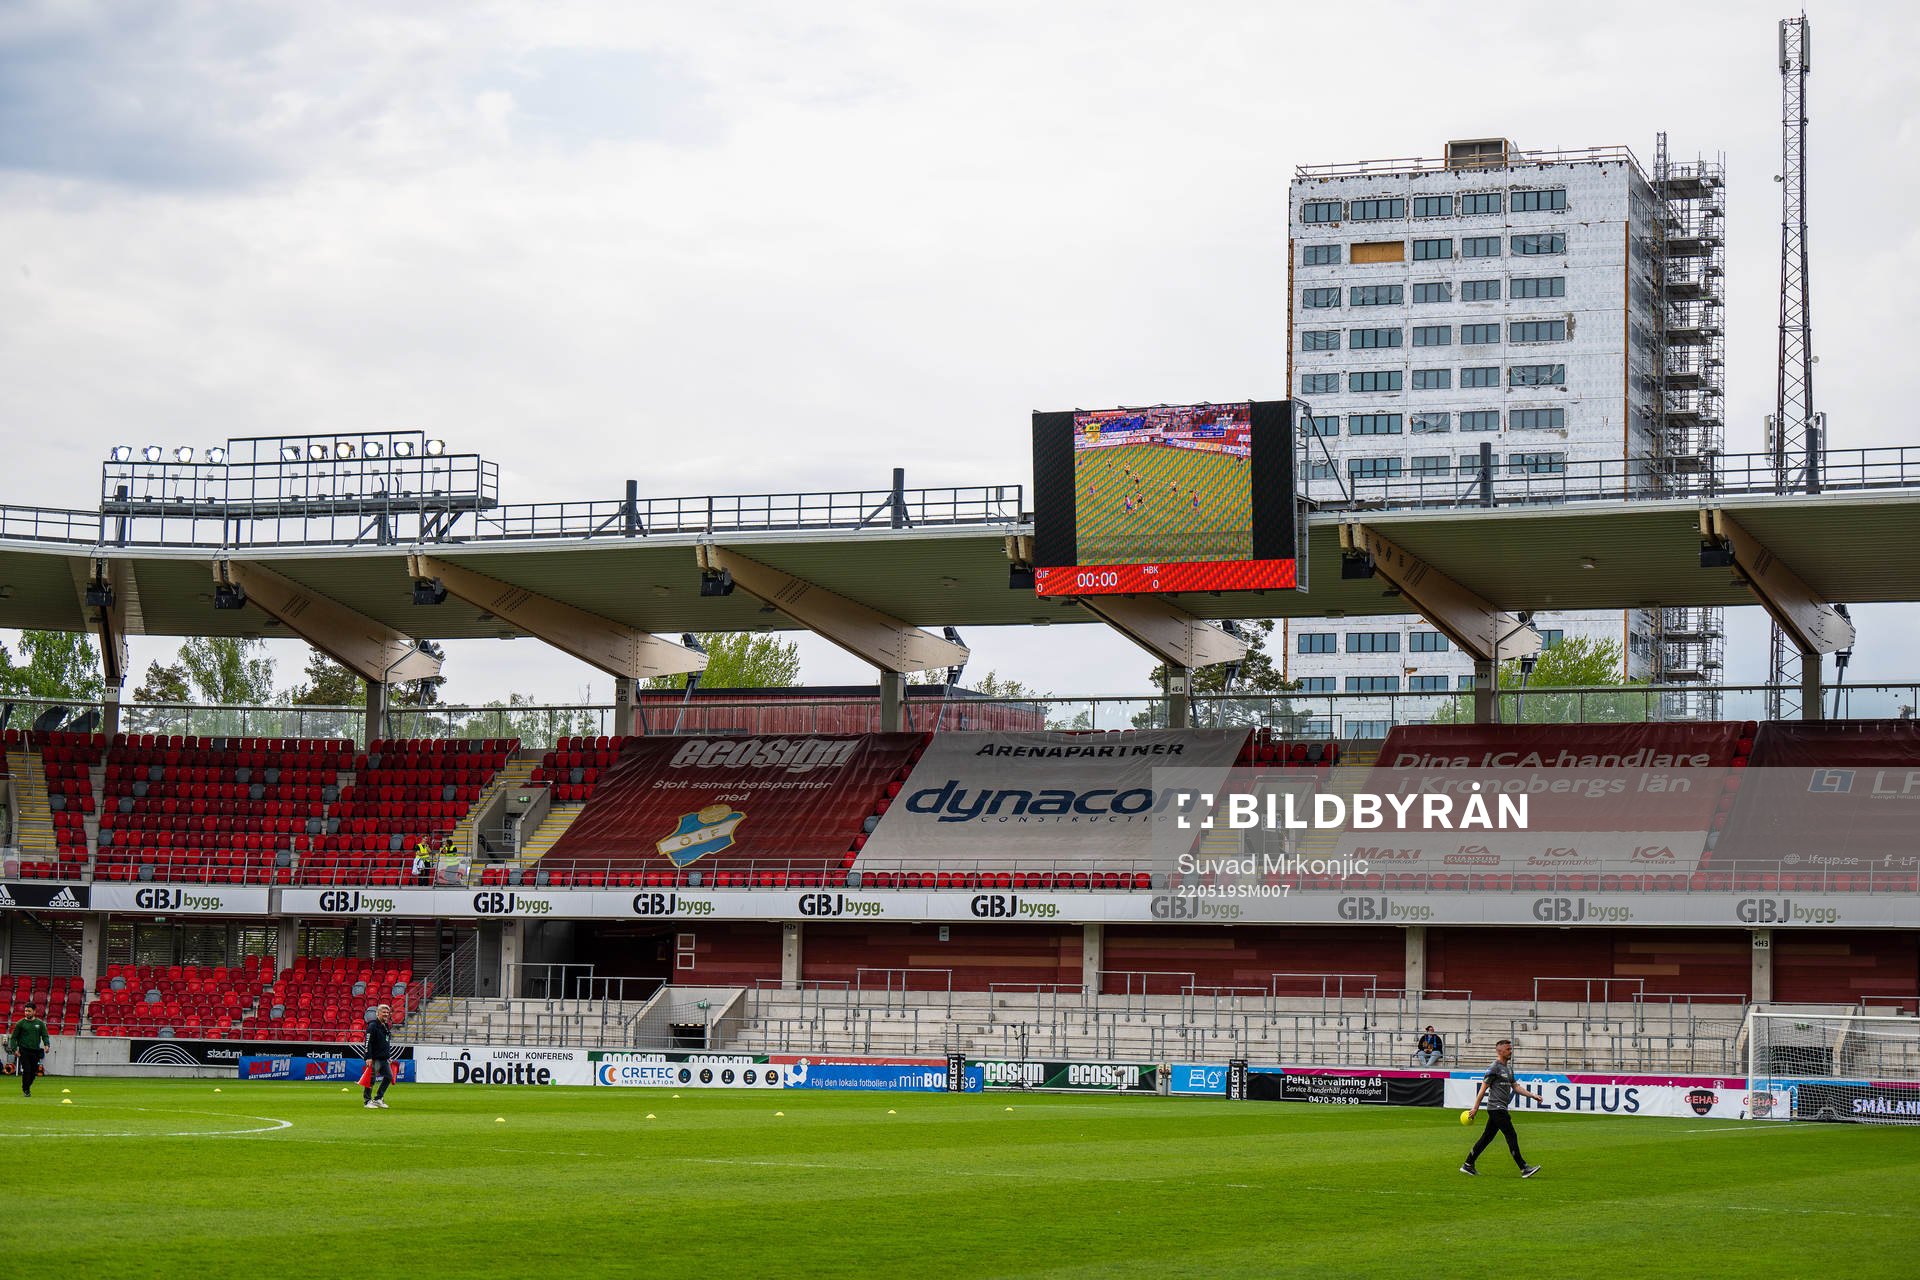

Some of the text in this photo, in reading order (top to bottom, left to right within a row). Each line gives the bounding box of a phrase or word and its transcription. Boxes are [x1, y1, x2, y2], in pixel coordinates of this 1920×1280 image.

[1078, 572, 1118, 587] 00:00
[1144, 566, 1158, 574] HBK
[1152, 580, 1158, 589] 0
[669, 739, 861, 773] ecosign
[976, 743, 1185, 758] ARENAPARTNER
[1392, 748, 1710, 771] Dina ICA-handlare
[691, 779, 832, 791] samarbetspartner
[1416, 774, 1628, 799] Kronobergs
[1638, 773, 1691, 793] län
[716, 792, 751, 801] med
[981, 815, 1189, 823] CONSTRUCTIO
[1352, 847, 1422, 859] MAXI
[1458, 845, 1490, 854] ICA
[1544, 847, 1578, 857] ICA
[1632, 846, 1675, 859] ICA
[49, 899, 80, 908] adidas
[136, 888, 223, 911] GBJ bygg.
[319, 891, 396, 912] GBJ bygg.
[473, 892, 553, 914] GBJ bygg.
[632, 893, 715, 915] GBJ bygg.
[798, 893, 884, 916] GBJ bygg.
[971, 895, 1060, 918] GBJ bygg.
[1150, 895, 1243, 919] GBJ bygg.
[1337, 897, 1434, 921] GBJ bygg.
[1533, 897, 1634, 922] GBJ bygg.
[1736, 898, 1841, 924] GBJ bygg.
[208, 1049, 242, 1058] stadium
[493, 1051, 573, 1060] LUNCH KONFERENS
[622, 1067, 674, 1078] CRETEC
[812, 1072, 976, 1088] Följ den lokala fotbollen på minBOLse
[950, 1059, 958, 1090] SELECT
[1068, 1065, 1139, 1090] ecosign
[1286, 1075, 1381, 1088] PeHå Förvaltning AB
[1286, 1085, 1306, 1093] Service
[1356, 1088, 1382, 1096] fastighet
[1309, 1096, 1347, 1104] 0470-285
[1684, 1095, 1719, 1105] GEHAB
[1853, 1097, 1920, 1114] SMÅLAN
